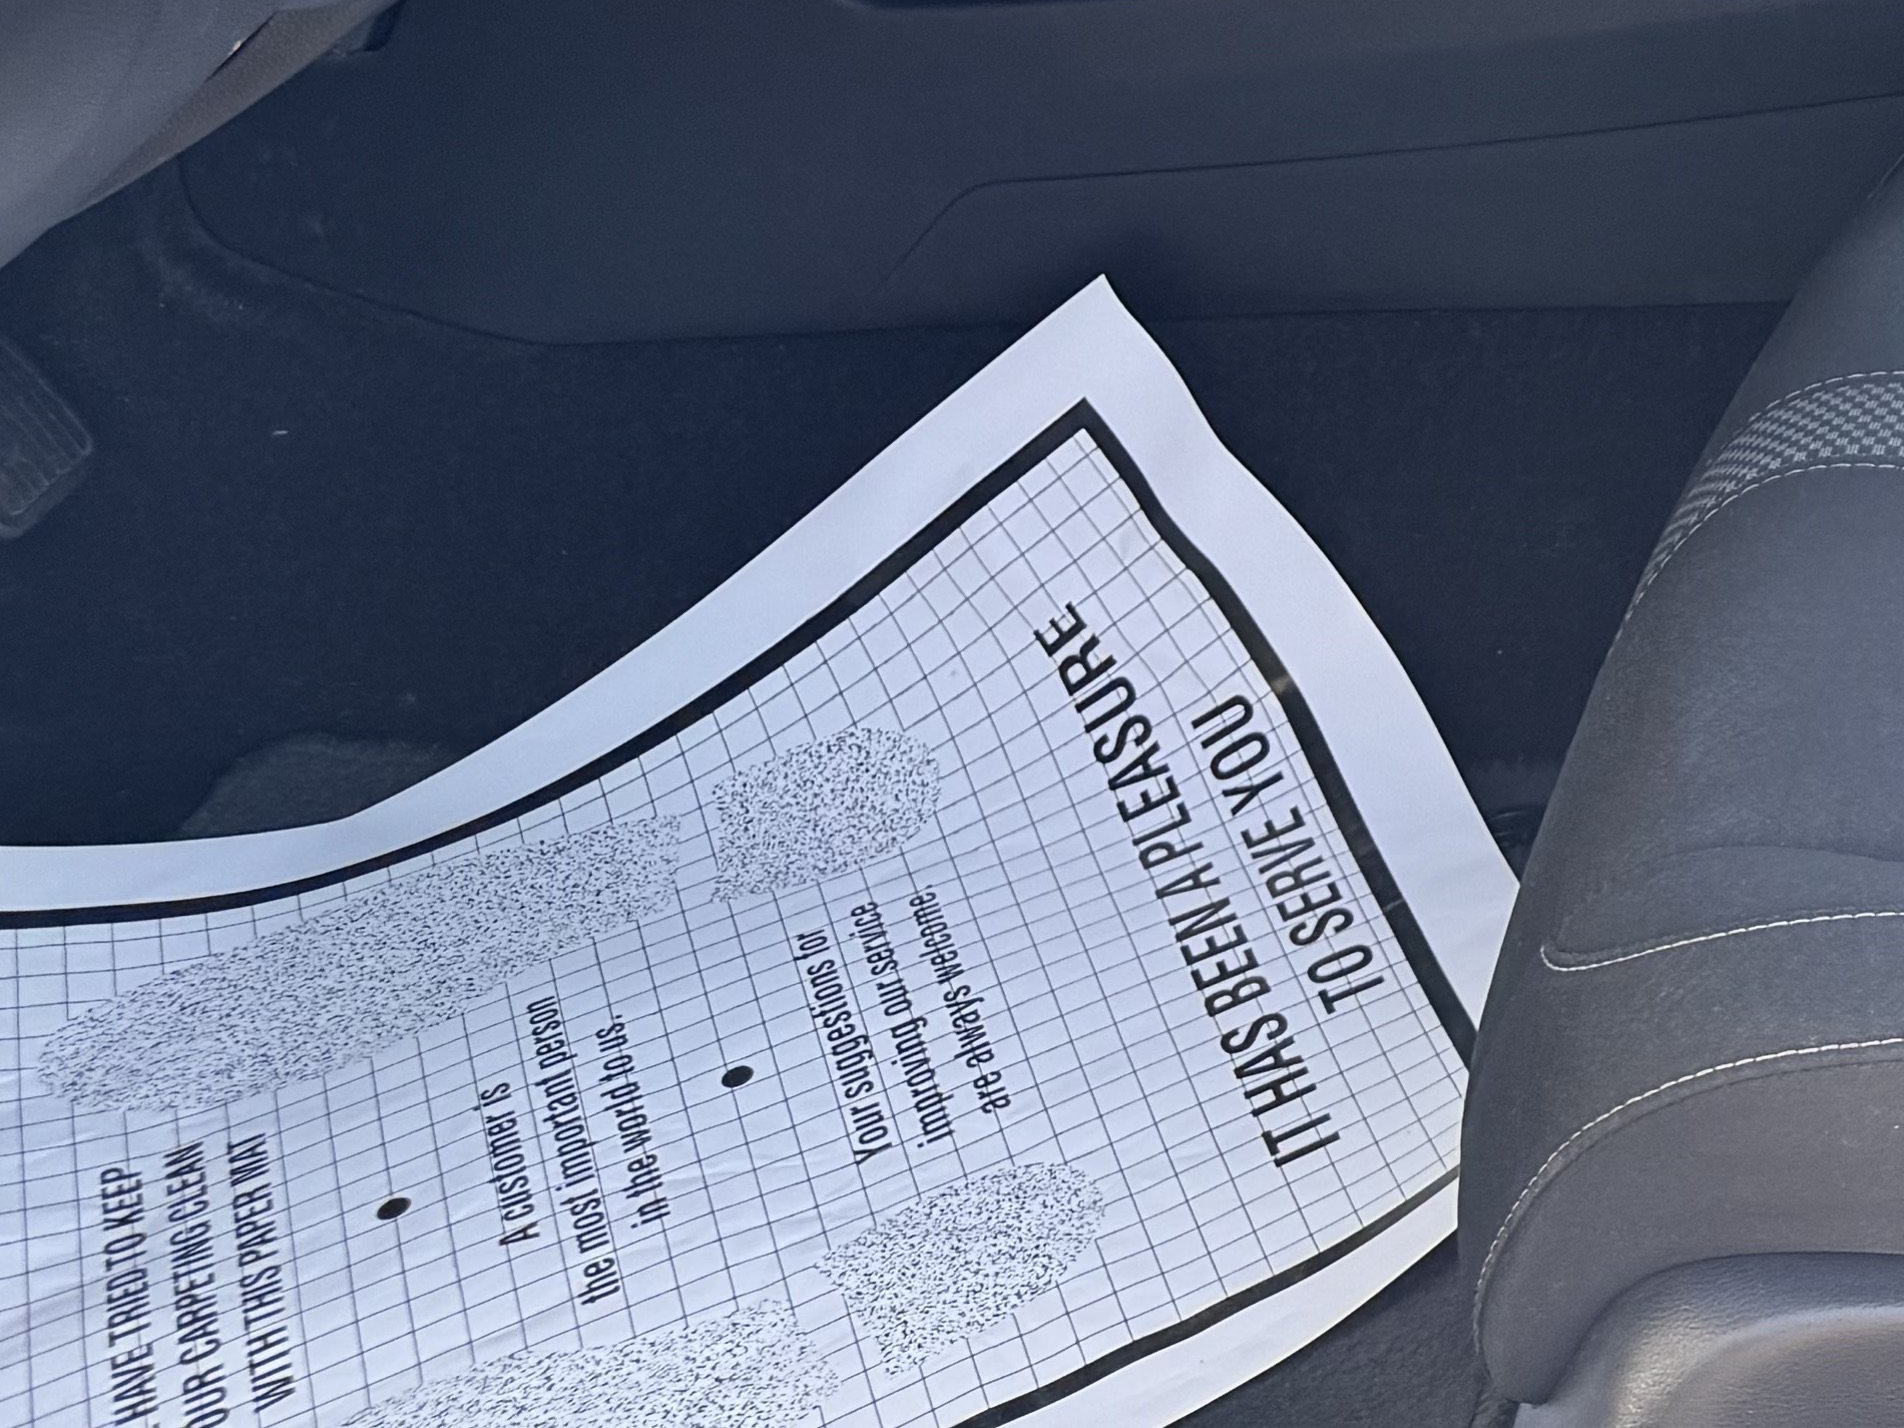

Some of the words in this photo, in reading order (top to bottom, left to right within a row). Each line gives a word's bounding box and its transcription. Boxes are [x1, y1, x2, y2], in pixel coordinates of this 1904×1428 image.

[1032, 600, 1205, 870] PLEASURE
[1191, 694, 1284, 817] YOU
[1155, 862, 1221, 900] A
[1241, 805, 1354, 948] SERVE
[794, 928, 830, 962] for
[848, 901, 900, 977] service
[1167, 896, 1272, 1018] BEEN
[876, 980, 914, 1017] our
[1306, 943, 1385, 1014] TO
[526, 995, 578, 1070] person
[806, 959, 876, 1100] suggestions
[942, 984, 994, 1069] always
[472, 1082, 512, 1112] is
[598, 1054, 636, 1083] to
[890, 1015, 956, 1149] improving
[973, 1070, 1012, 1114] are
[1220, 1011, 1318, 1117] HAS
[534, 1069, 597, 1193] important
[600, 1080, 652, 1154] world
[850, 1101, 893, 1166] Your
[1260, 1113, 1341, 1167] IT
[163, 1141, 211, 1223] CLEAN
[227, 1133, 270, 1186] MAT
[485, 1109, 535, 1222] customer
[621, 1153, 664, 1200] the
[100, 1166, 145, 1231] KEEP
[232, 1182, 279, 1267] PAPER
[499, 1221, 540, 1247] A
[559, 1187, 610, 1255] most
[630, 1195, 672, 1229] in
[103, 1232, 148, 1272] TO
[578, 1257, 622, 1306] the
[106, 1266, 152, 1347] TRIED
[170, 1219, 222, 1366] CARPETING
[239, 1264, 286, 1331] THIS
[110, 1341, 159, 1427] HAVE
[246, 1325, 295, 1413] WITH
